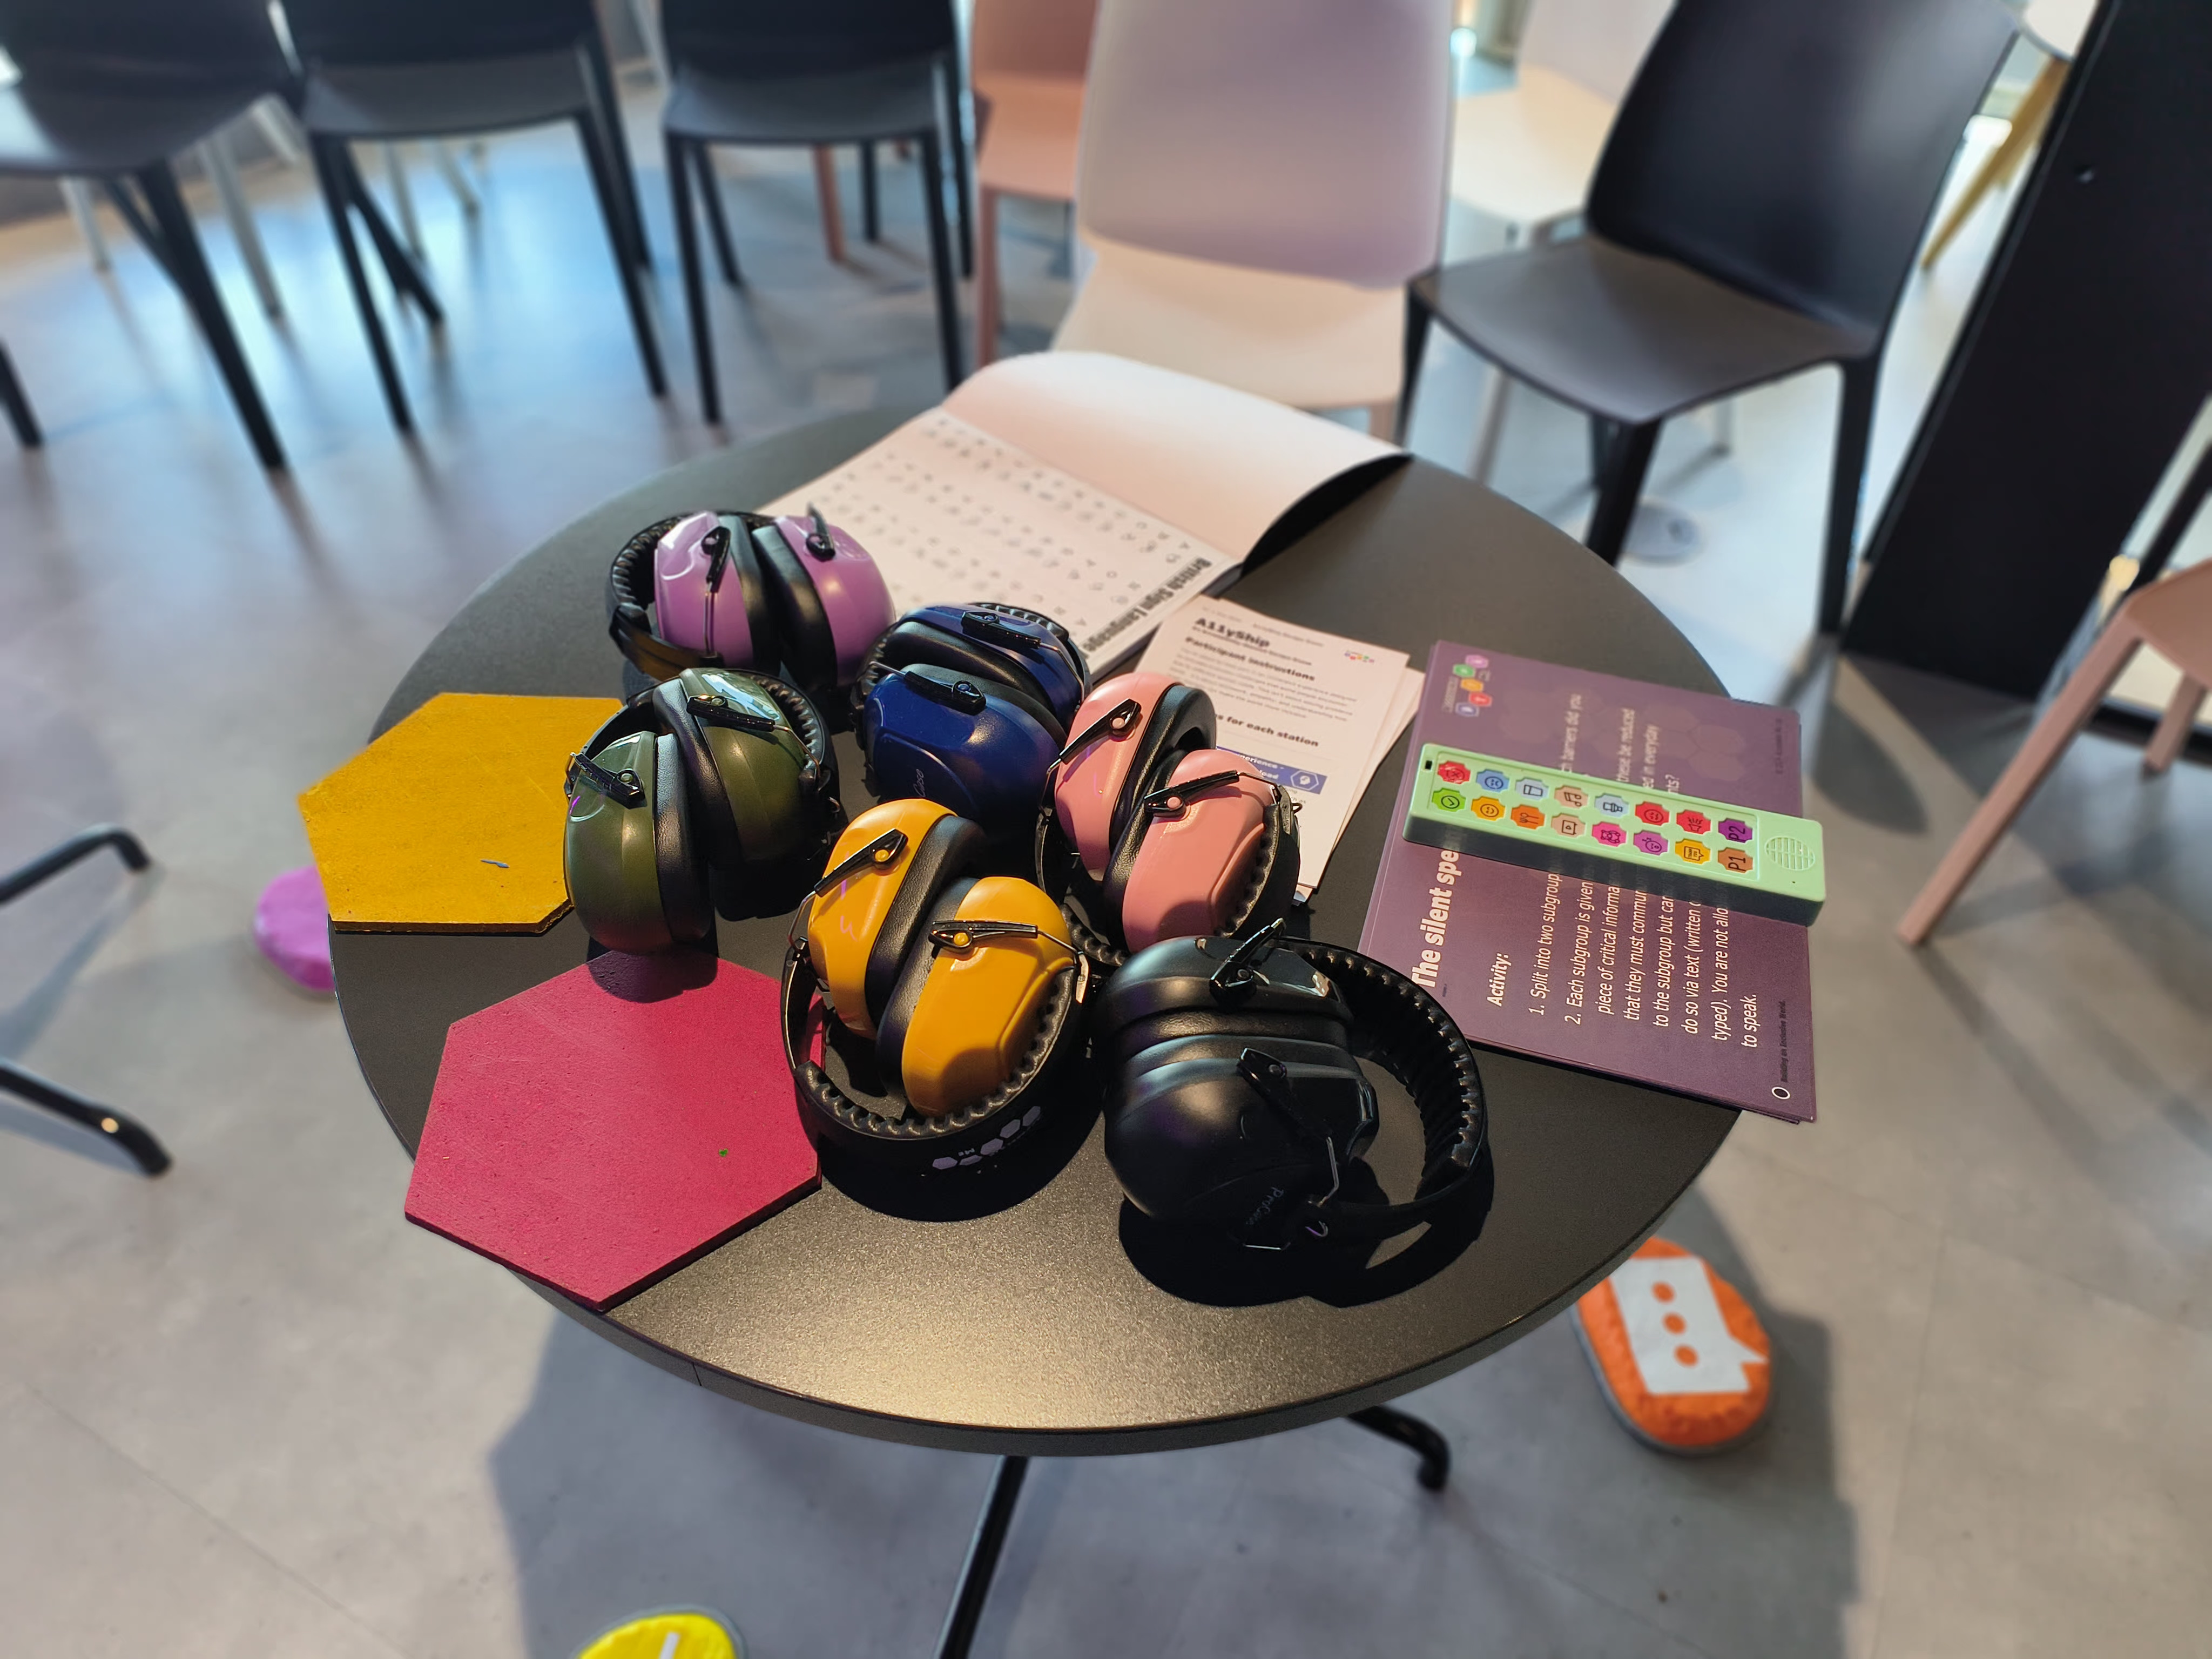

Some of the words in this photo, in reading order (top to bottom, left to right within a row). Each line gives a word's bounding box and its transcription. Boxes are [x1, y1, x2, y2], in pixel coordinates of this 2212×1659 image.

[1168, 557, 1212, 590] British
[1139, 588, 1174, 610] Sign
[1083, 608, 1148, 651] Language
[1196, 618, 1270, 647] A11yShip
[1185, 637, 1246, 661] Participant
[1249, 658, 1314, 680] instructions
[1227, 717, 1243, 725] for
[1247, 724, 1274, 734] each
[1277, 732, 1318, 746] station
[1729, 826, 1745, 843] P2
[1728, 856, 1746, 872] P1
[1576, 882, 1595, 911] given
[1419, 887, 1452, 946] silent
[1574, 912, 1590, 922] is
[1656, 914, 1673, 934] but
[1537, 925, 1554, 945] two
[1683, 909, 1704, 952] (written
[1712, 929, 1728, 948] not
[1533, 948, 1551, 970] into
[1569, 925, 1593, 977] subgroup
[1599, 928, 1616, 966] critical
[1629, 935, 1644, 965] must
[1411, 949, 1441, 988] The
[1654, 936, 1676, 990] subgroup
[1683, 954, 1700, 978] text
[1715, 950, 1728, 970] are
[1487, 953, 1512, 1007] Activity:
[1530, 972, 1550, 999] Split
[1597, 966, 1614, 980] of
[1624, 967, 1646, 993] they
[1711, 972, 1728, 993] You
[1566, 979, 1584, 1008] Each
[1595, 983, 1615, 1015] piece
[1652, 992, 1670, 1011] the
[1682, 981, 1699, 997] via
[1528, 1005, 1545, 1016] 1.
[1564, 1014, 1581, 1025] 2.
[1622, 995, 1641, 1020] that
[1685, 1001, 1698, 1016] so
[1710, 999, 1731, 1041] typed).
[1739, 994, 1761, 1032] speak.
[1652, 1014, 1669, 1027] to
[1681, 1019, 1698, 1034] do
[1741, 1035, 1757, 1048] to
